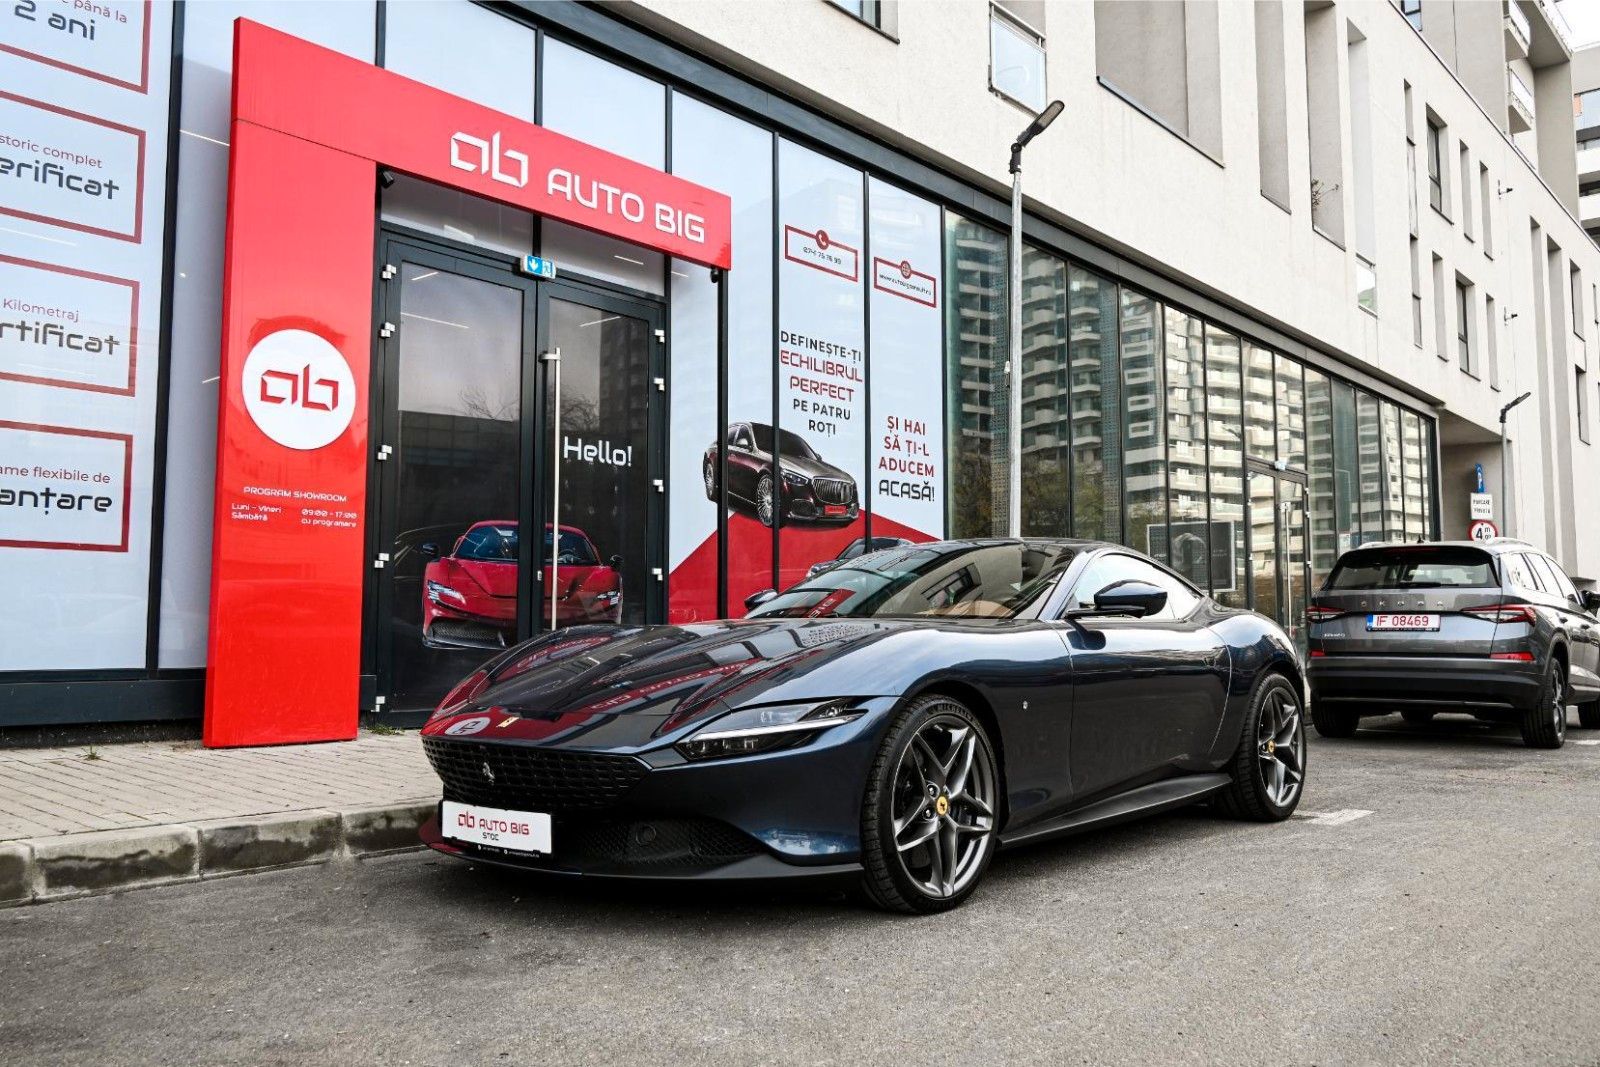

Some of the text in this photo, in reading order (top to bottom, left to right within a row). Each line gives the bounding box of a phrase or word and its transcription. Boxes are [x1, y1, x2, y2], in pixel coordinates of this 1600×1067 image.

[14, 0, 95, 41] 2 ani
[115, 10, 128, 23] la
[43, 147, 103, 169] complet
[547, 168, 645, 223] AUTO
[655, 202, 705, 244] BIG
[3, 298, 79, 323] Kilometraj
[780, 349, 863, 383] ECHILIBRUL
[790, 376, 855, 402] PERFECT
[793, 399, 851, 420] PE PATRU
[808, 419, 837, 437] ROȚI
[887, 416, 926, 436] ȘI HAI
[563, 436, 632, 467] Hello!
[884, 435, 930, 457] SĂ ȚI-L
[33, 466, 89, 482] flexibile
[93, 471, 111, 484] de
[878, 456, 935, 477] ADUCEM
[243, 486, 347, 503] PROGRAM SHOWROOM
[879, 479, 935, 501] ACASĂ!
[231, 503, 250, 511] Luni
[1376, 615, 1429, 627] IF 08469
[479, 819, 508, 833] AUTO
[511, 823, 530, 836] BIG
[482, 831, 499, 841] STOC
